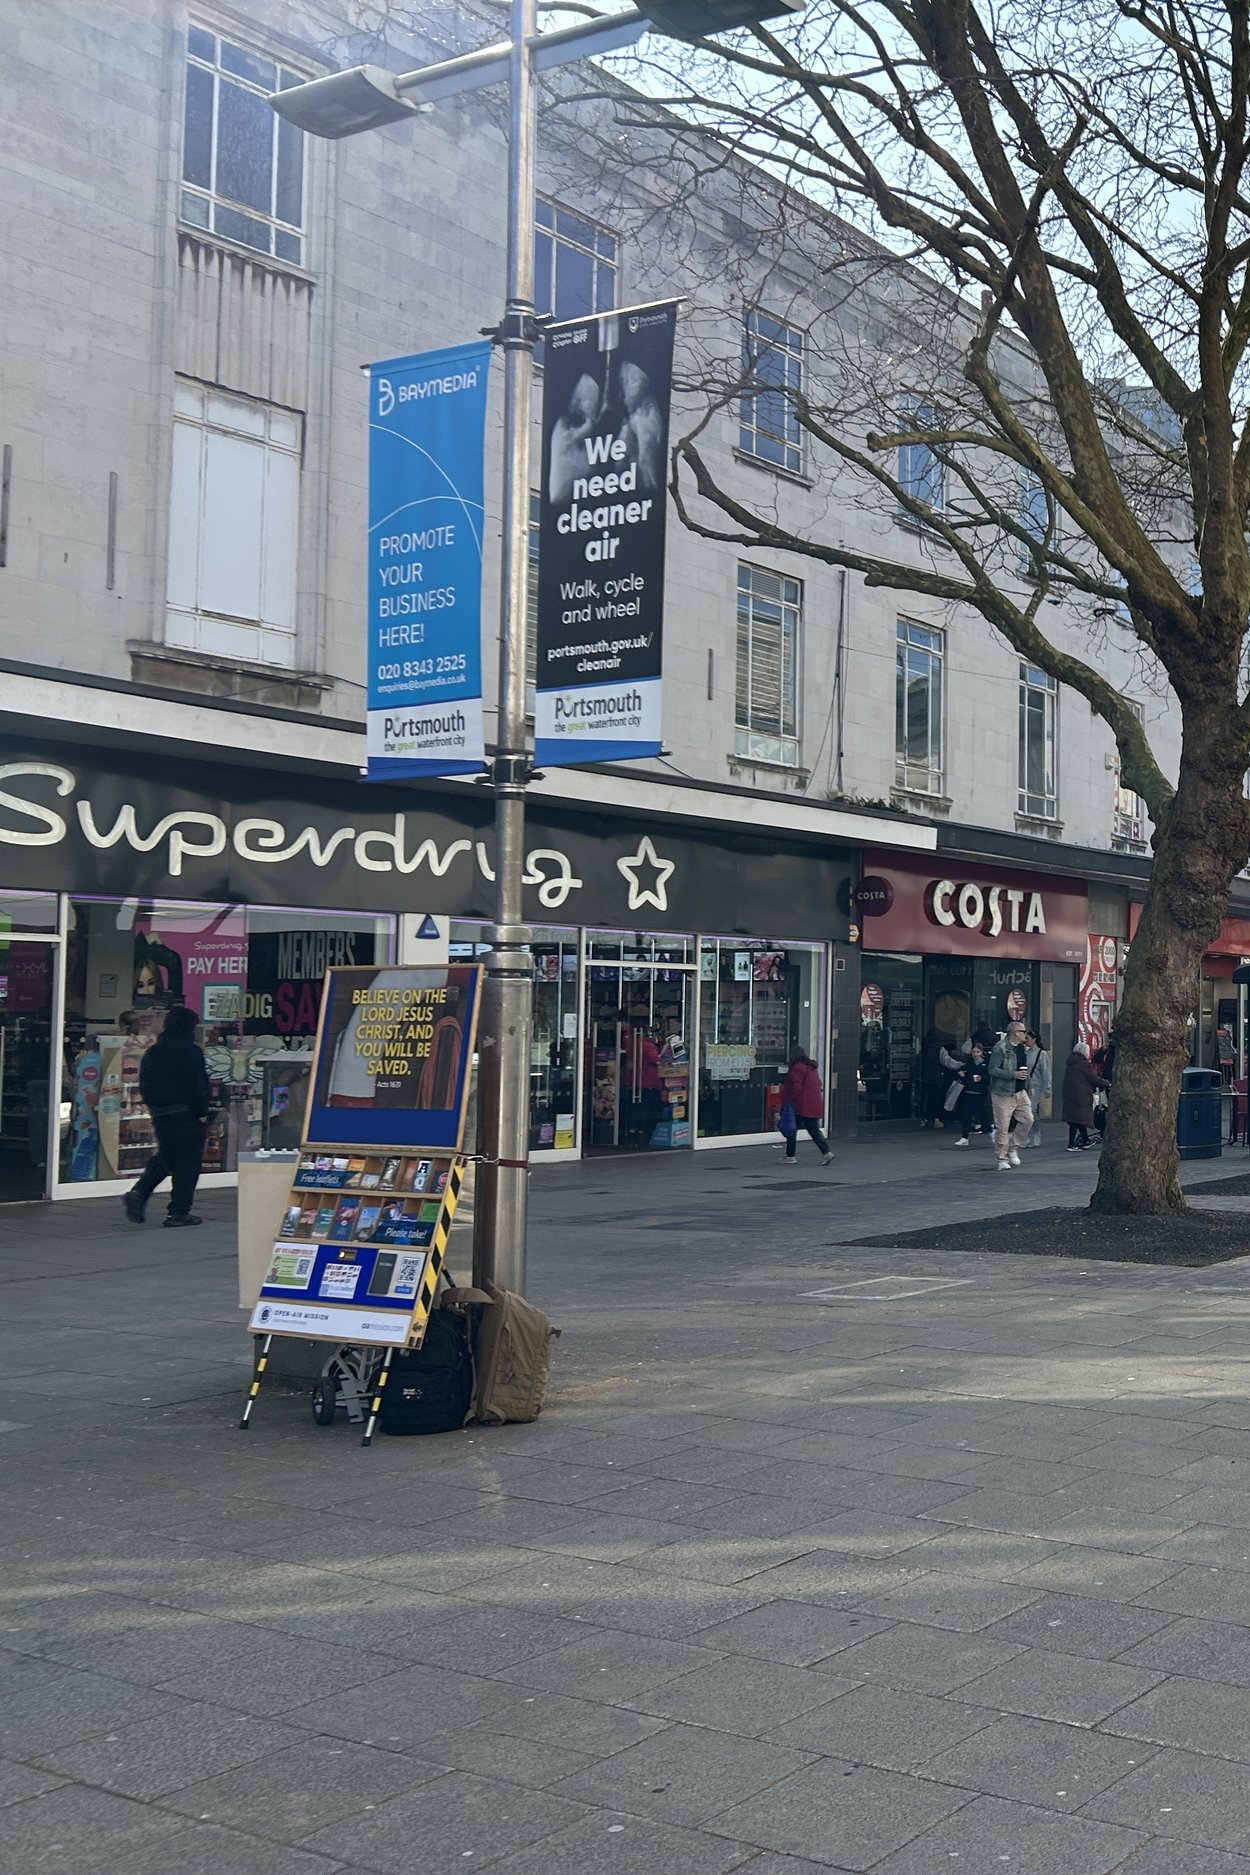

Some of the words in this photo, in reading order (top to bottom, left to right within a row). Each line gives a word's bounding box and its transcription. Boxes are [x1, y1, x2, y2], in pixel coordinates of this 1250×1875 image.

[398, 371, 477, 402] BAYMEDIA
[584, 433, 627, 465] We
[573, 462, 637, 500] need
[557, 499, 653, 534] cleaner
[380, 525, 455, 557] PROMOTE
[585, 530, 620, 562] air
[379, 562, 423, 587] YOUR
[559, 579, 600, 600] Walk,
[603, 572, 645, 598] cycle
[379, 586, 456, 618] BUSINESS
[561, 604, 592, 625] and
[595, 596, 641, 620] wheel
[379, 623, 425, 648] HERE!
[377, 663, 401, 680] 020
[402, 659, 433, 677] 8343
[436, 654, 467, 672] 2525
[576, 655, 622, 672] cleanair
[554, 688, 642, 720] Portsmouth
[384, 709, 465, 739] Portsmouth
[554, 722, 566, 733] the
[566, 721, 587, 734] great
[588, 717, 628, 730] waterfront
[628, 714, 642, 728] city
[384, 742, 396, 752] the
[396, 741, 416, 753] great
[417, 737, 452, 749] waterfront
[453, 734, 465, 747] city
[857, 891, 885, 900] COSTA
[933, 879, 1047, 937] COSTA
[187, 957, 215, 975] PAY
[277, 931, 357, 980] MEMBERS
[275, 982, 323, 1032] SA
[352, 989, 400, 1005] BELIEVE
[401, 989, 421, 1004] ON
[424, 988, 448, 1003] THE
[361, 1007, 395, 1022] LORD
[396, 1006, 434, 1022] JESUS
[356, 1024, 403, 1041] CHRIST,
[405, 1024, 434, 1040] AND
[355, 1042, 382, 1057] YOU
[384, 1042, 414, 1057] WILL
[416, 1042, 431, 1057] BE
[366, 1060, 412, 1075] SAVED.
[299, 1172, 316, 1184] Free
[316, 1174, 340, 1185] leaflets
[384, 1227, 408, 1238] Please
[407, 1229, 428, 1240] take!
[273, 1309, 303, 1319] OPEN-AIR
[303, 1312, 330, 1321] MISSION
